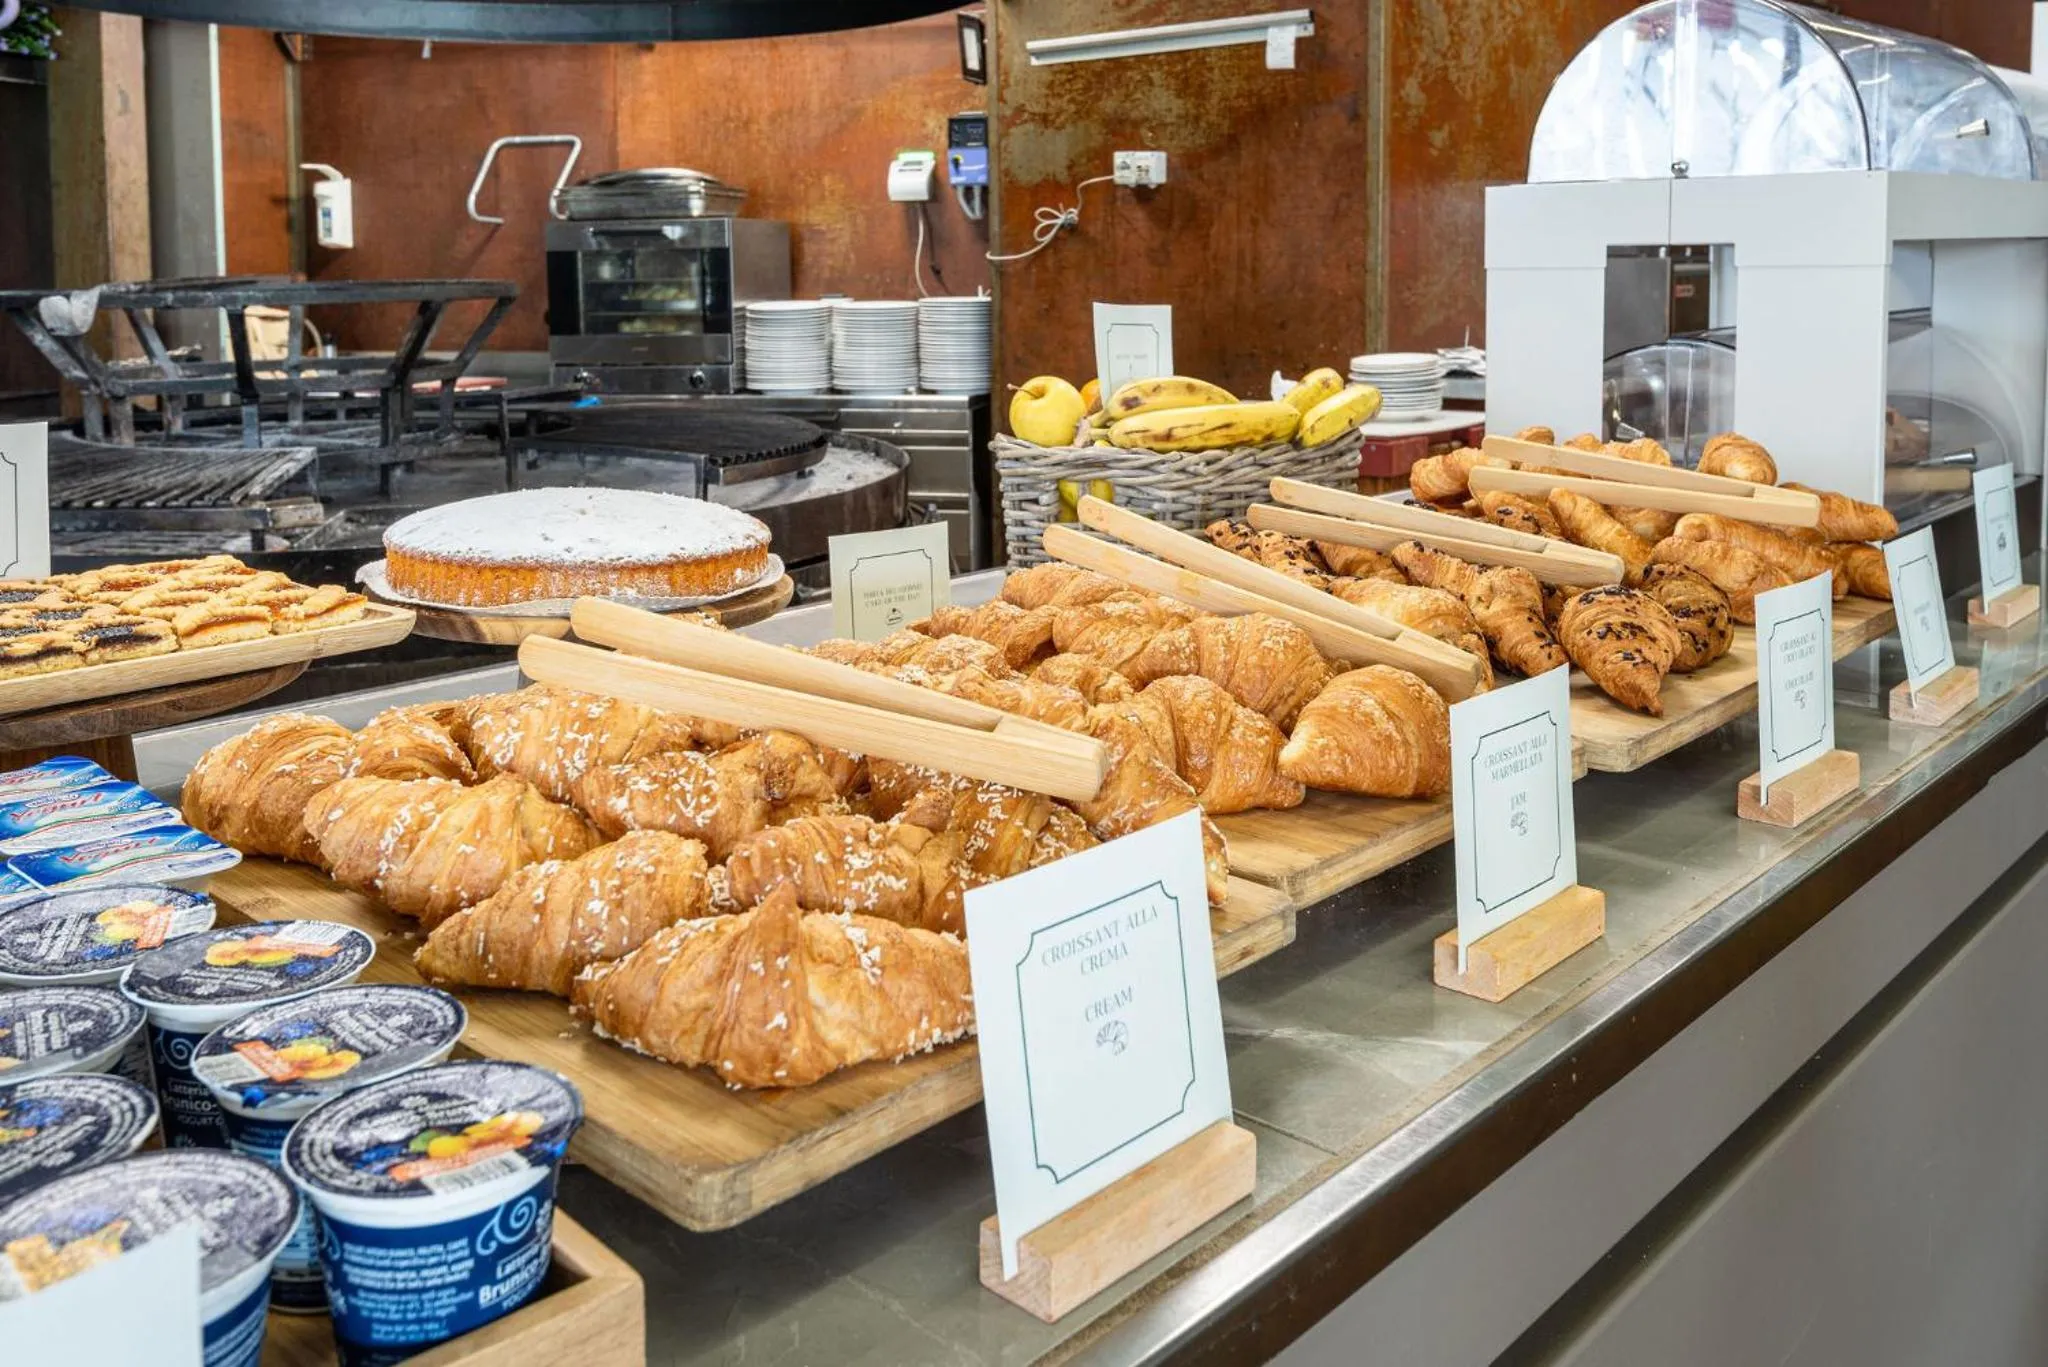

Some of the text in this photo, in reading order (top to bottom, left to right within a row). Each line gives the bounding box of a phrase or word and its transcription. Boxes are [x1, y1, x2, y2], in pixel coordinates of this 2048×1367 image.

[1484, 733, 1548, 768] CROISSANT ALLA
[1491, 751, 1543, 782] MARMELLATA
[1041, 903, 1160, 968] CROISSANT ALLA
[1080, 940, 1129, 975] CREMA
[1085, 984, 1135, 1022] CREAM
